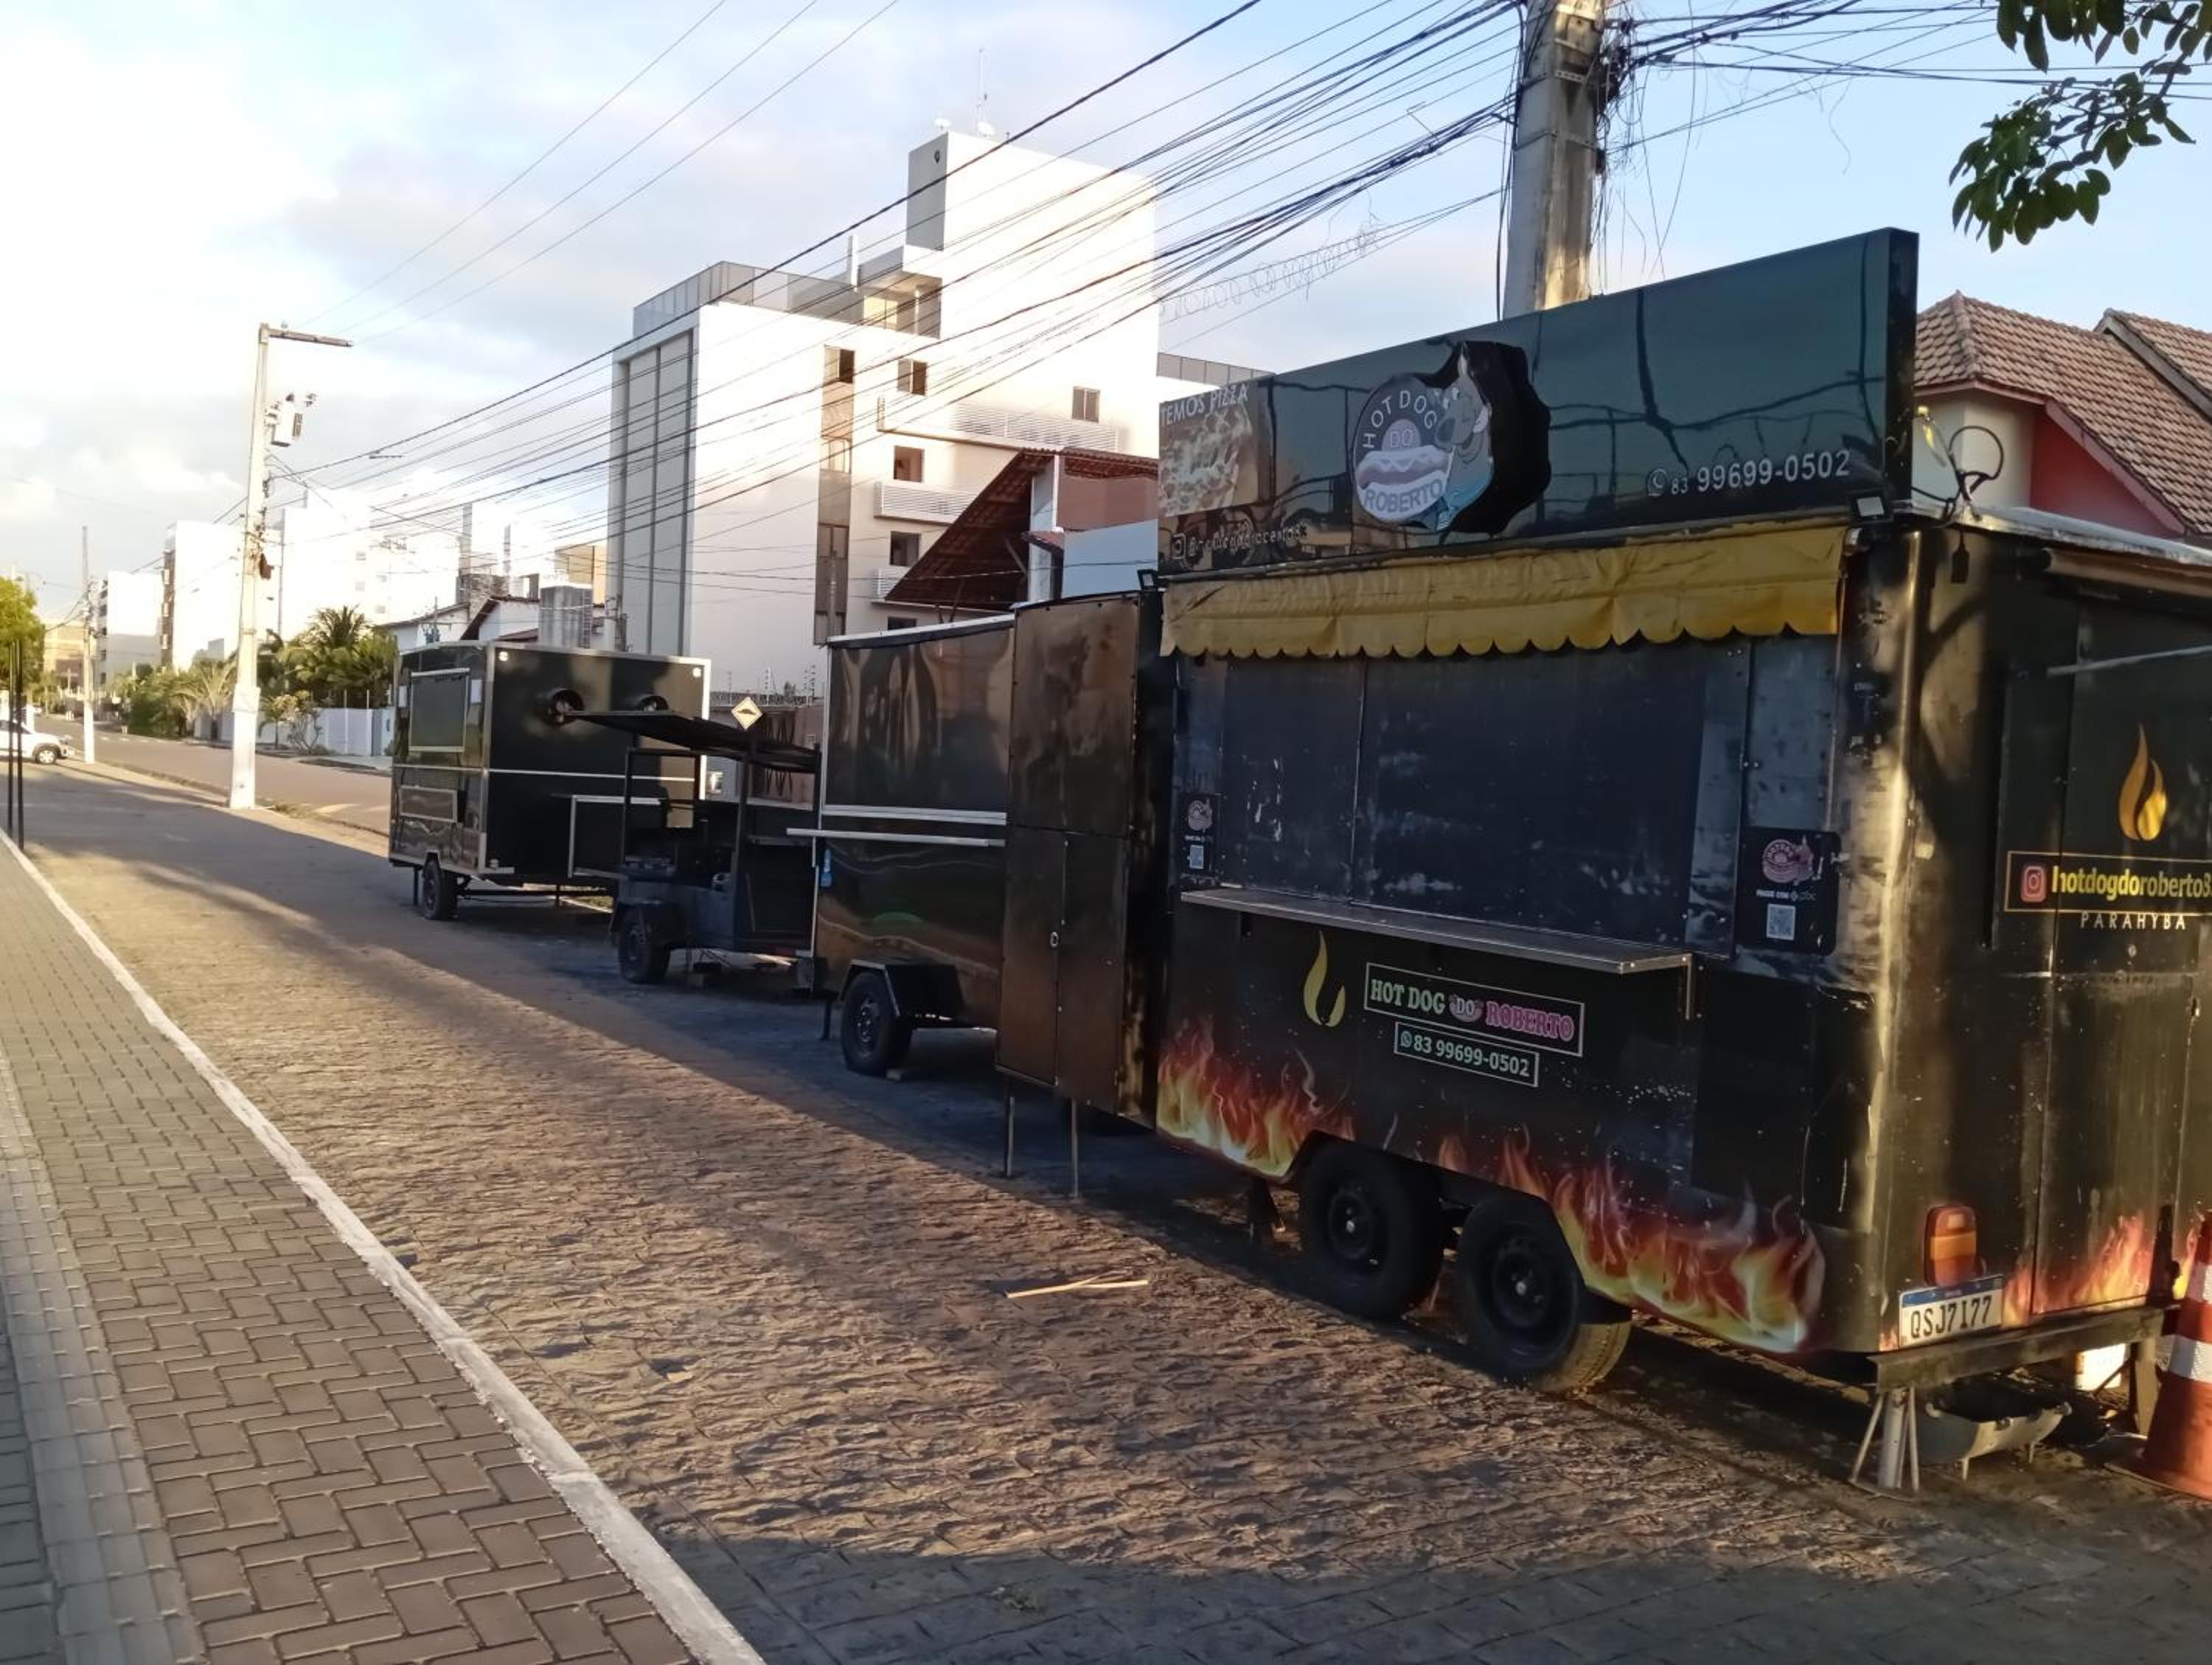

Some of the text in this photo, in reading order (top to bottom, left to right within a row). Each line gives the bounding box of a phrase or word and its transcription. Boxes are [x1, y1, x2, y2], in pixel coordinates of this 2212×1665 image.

[1209, 383, 1248, 414] PIZZA
[1363, 390, 1437, 448] HOT DOG
[1671, 449, 1851, 496] 83 99699-0502
[1364, 479, 1443, 513] ROBERTO
[2052, 865, 2212, 901] hotdogdoroberto8
[2079, 911, 2187, 930] PARAHYBA
[1370, 979, 1575, 1042] HOT DOG DO ROBERTO
[1413, 1034, 1531, 1077] 83 99699-0502
